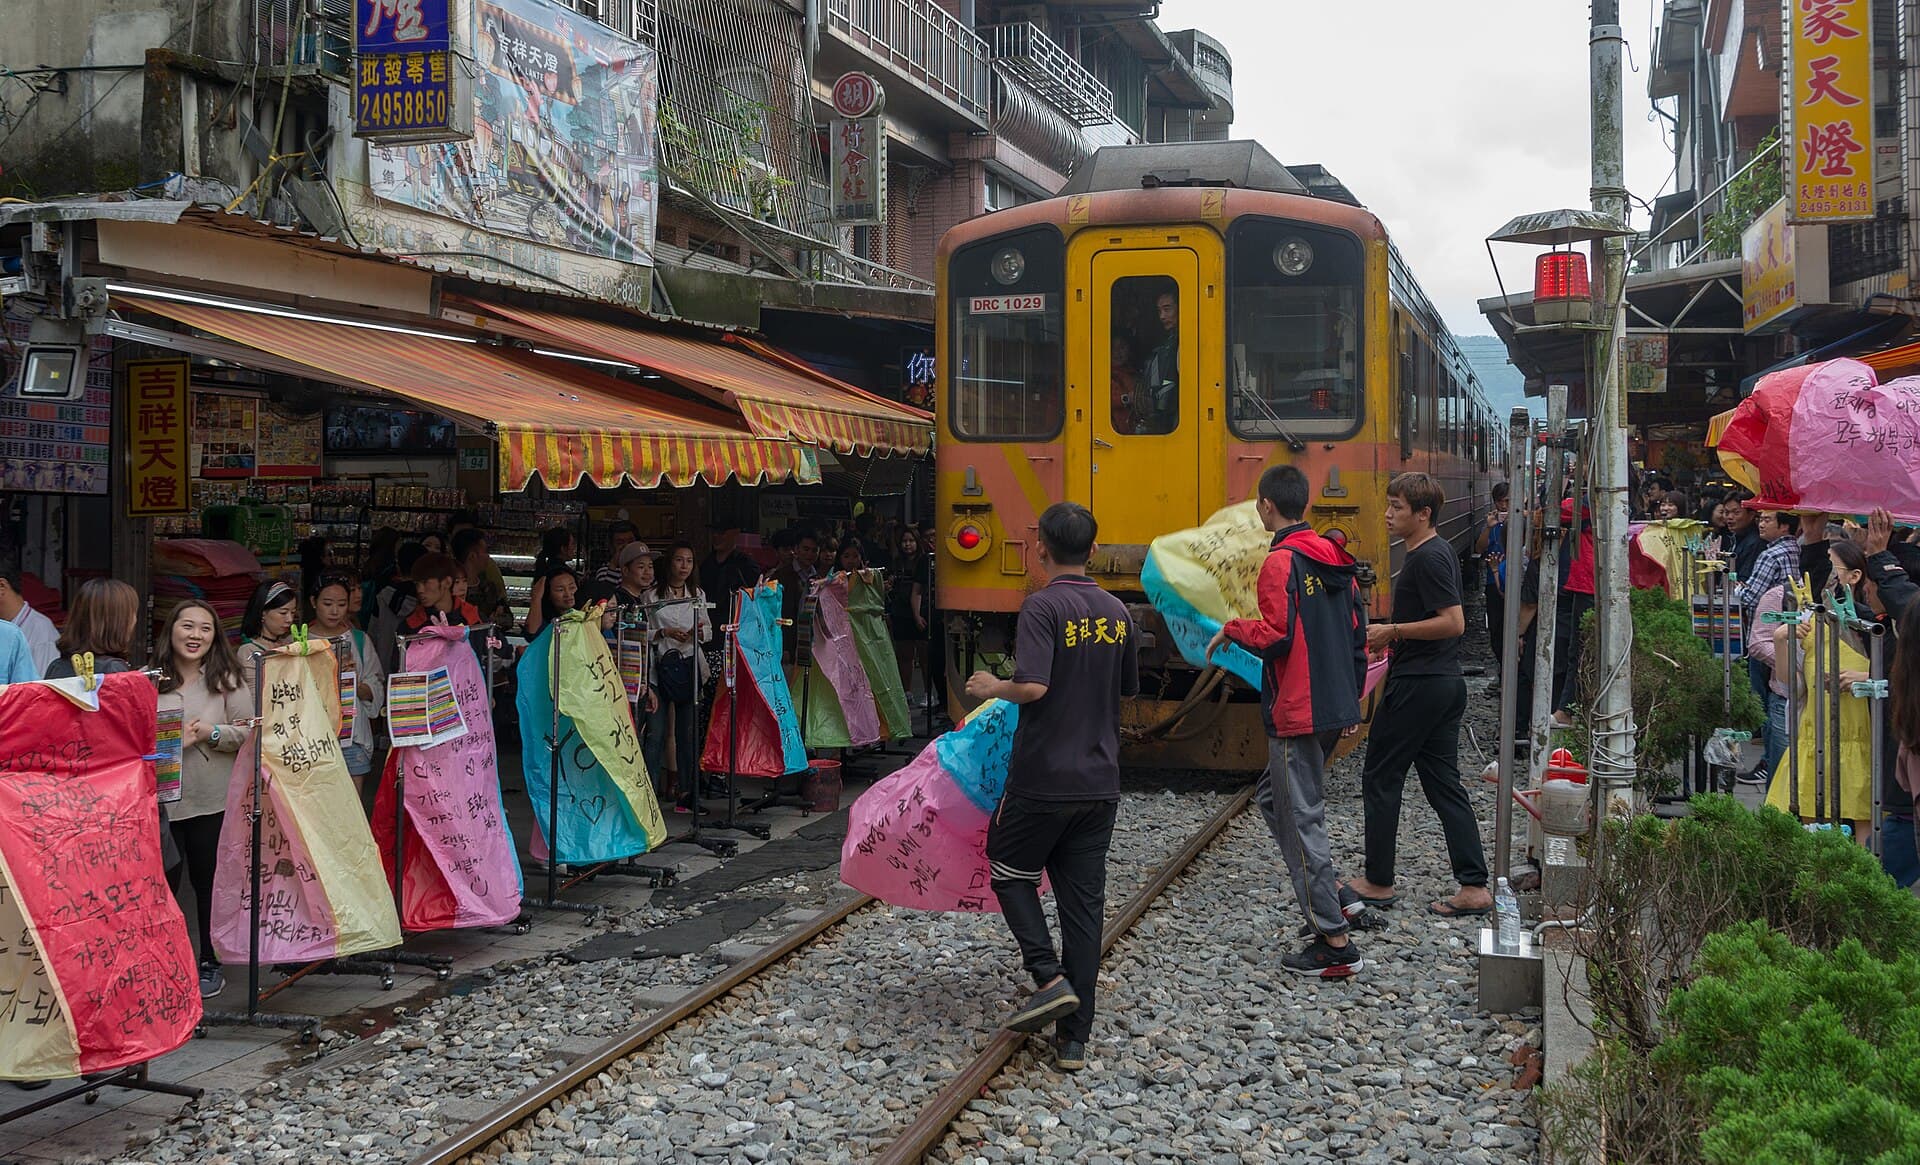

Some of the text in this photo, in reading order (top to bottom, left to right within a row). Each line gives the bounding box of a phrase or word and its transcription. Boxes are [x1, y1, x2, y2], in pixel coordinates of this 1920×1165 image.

[361, 50, 447, 87] 批發零售
[498, 32, 559, 73] 吉祥天燈
[361, 89, 446, 127] 24958850
[1800, 201, 1868, 214] 2495-8131
[973, 297, 1042, 312] DRC 1029
[138, 367, 178, 508] 吉祥天燈
[1866, 422, 1920, 456] 행복하
[470, 456, 484, 470] 94
